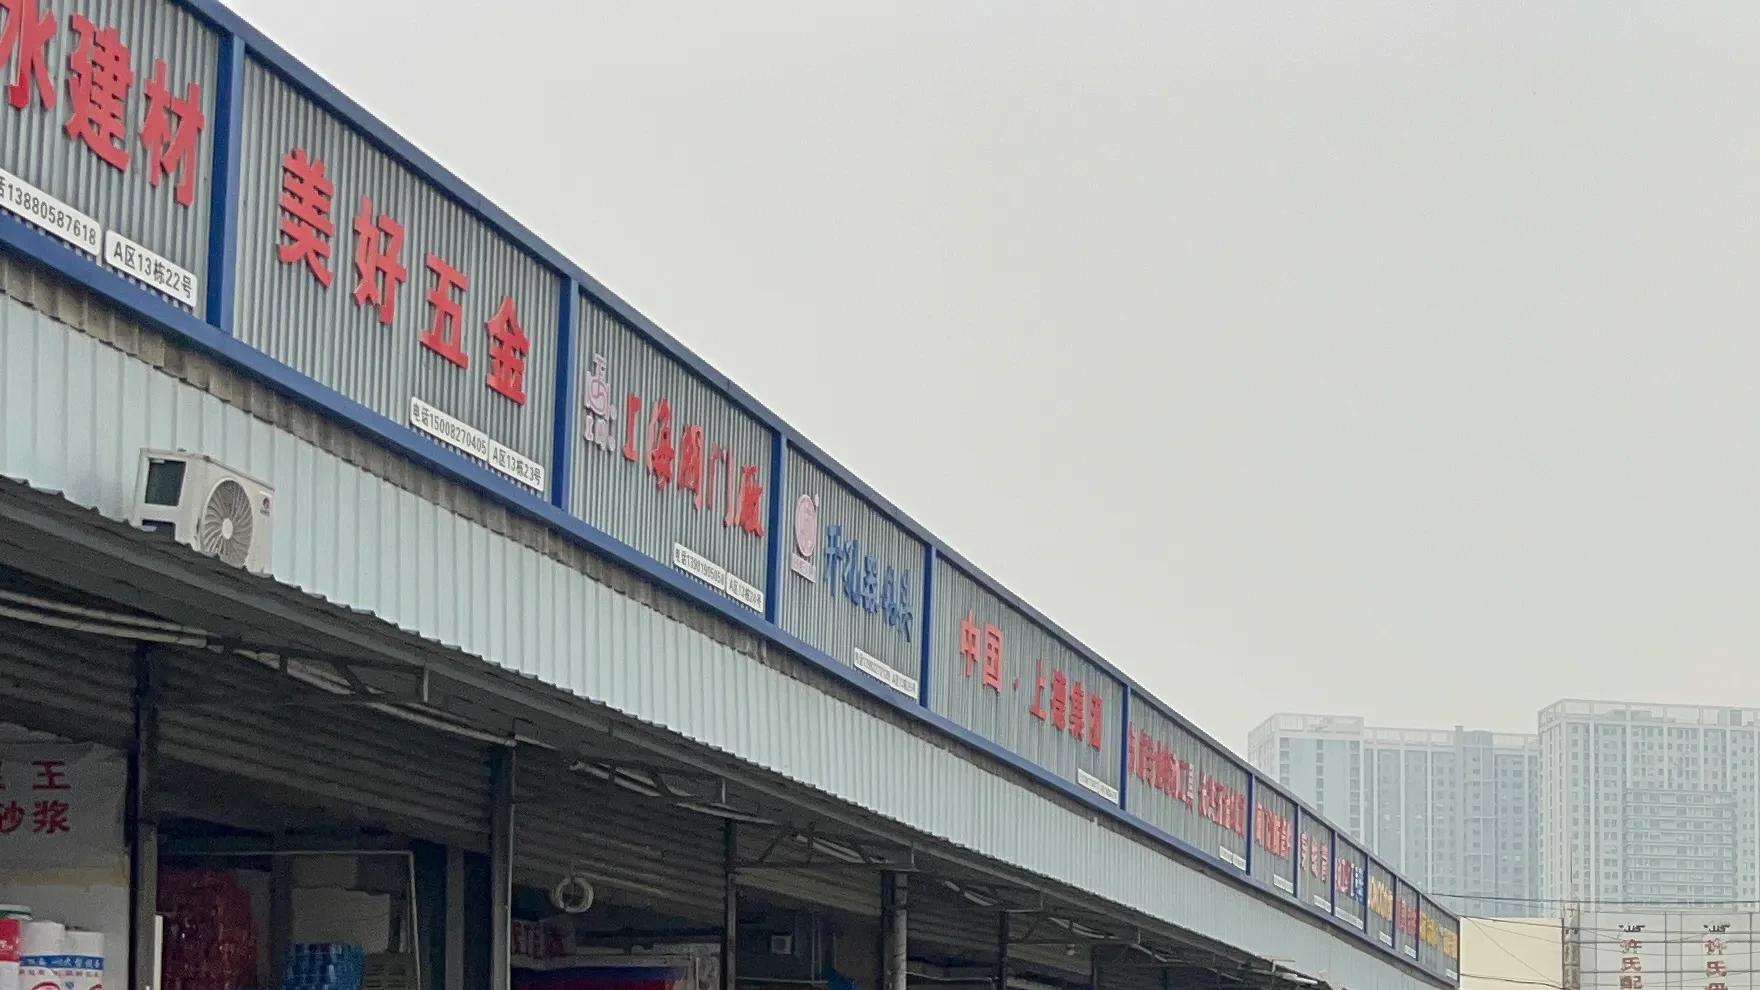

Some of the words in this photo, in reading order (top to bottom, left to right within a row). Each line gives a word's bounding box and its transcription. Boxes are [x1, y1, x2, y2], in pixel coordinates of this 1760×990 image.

[114, 240, 193, 299] A区13栋22号
[277, 147, 531, 406] 美好五金
